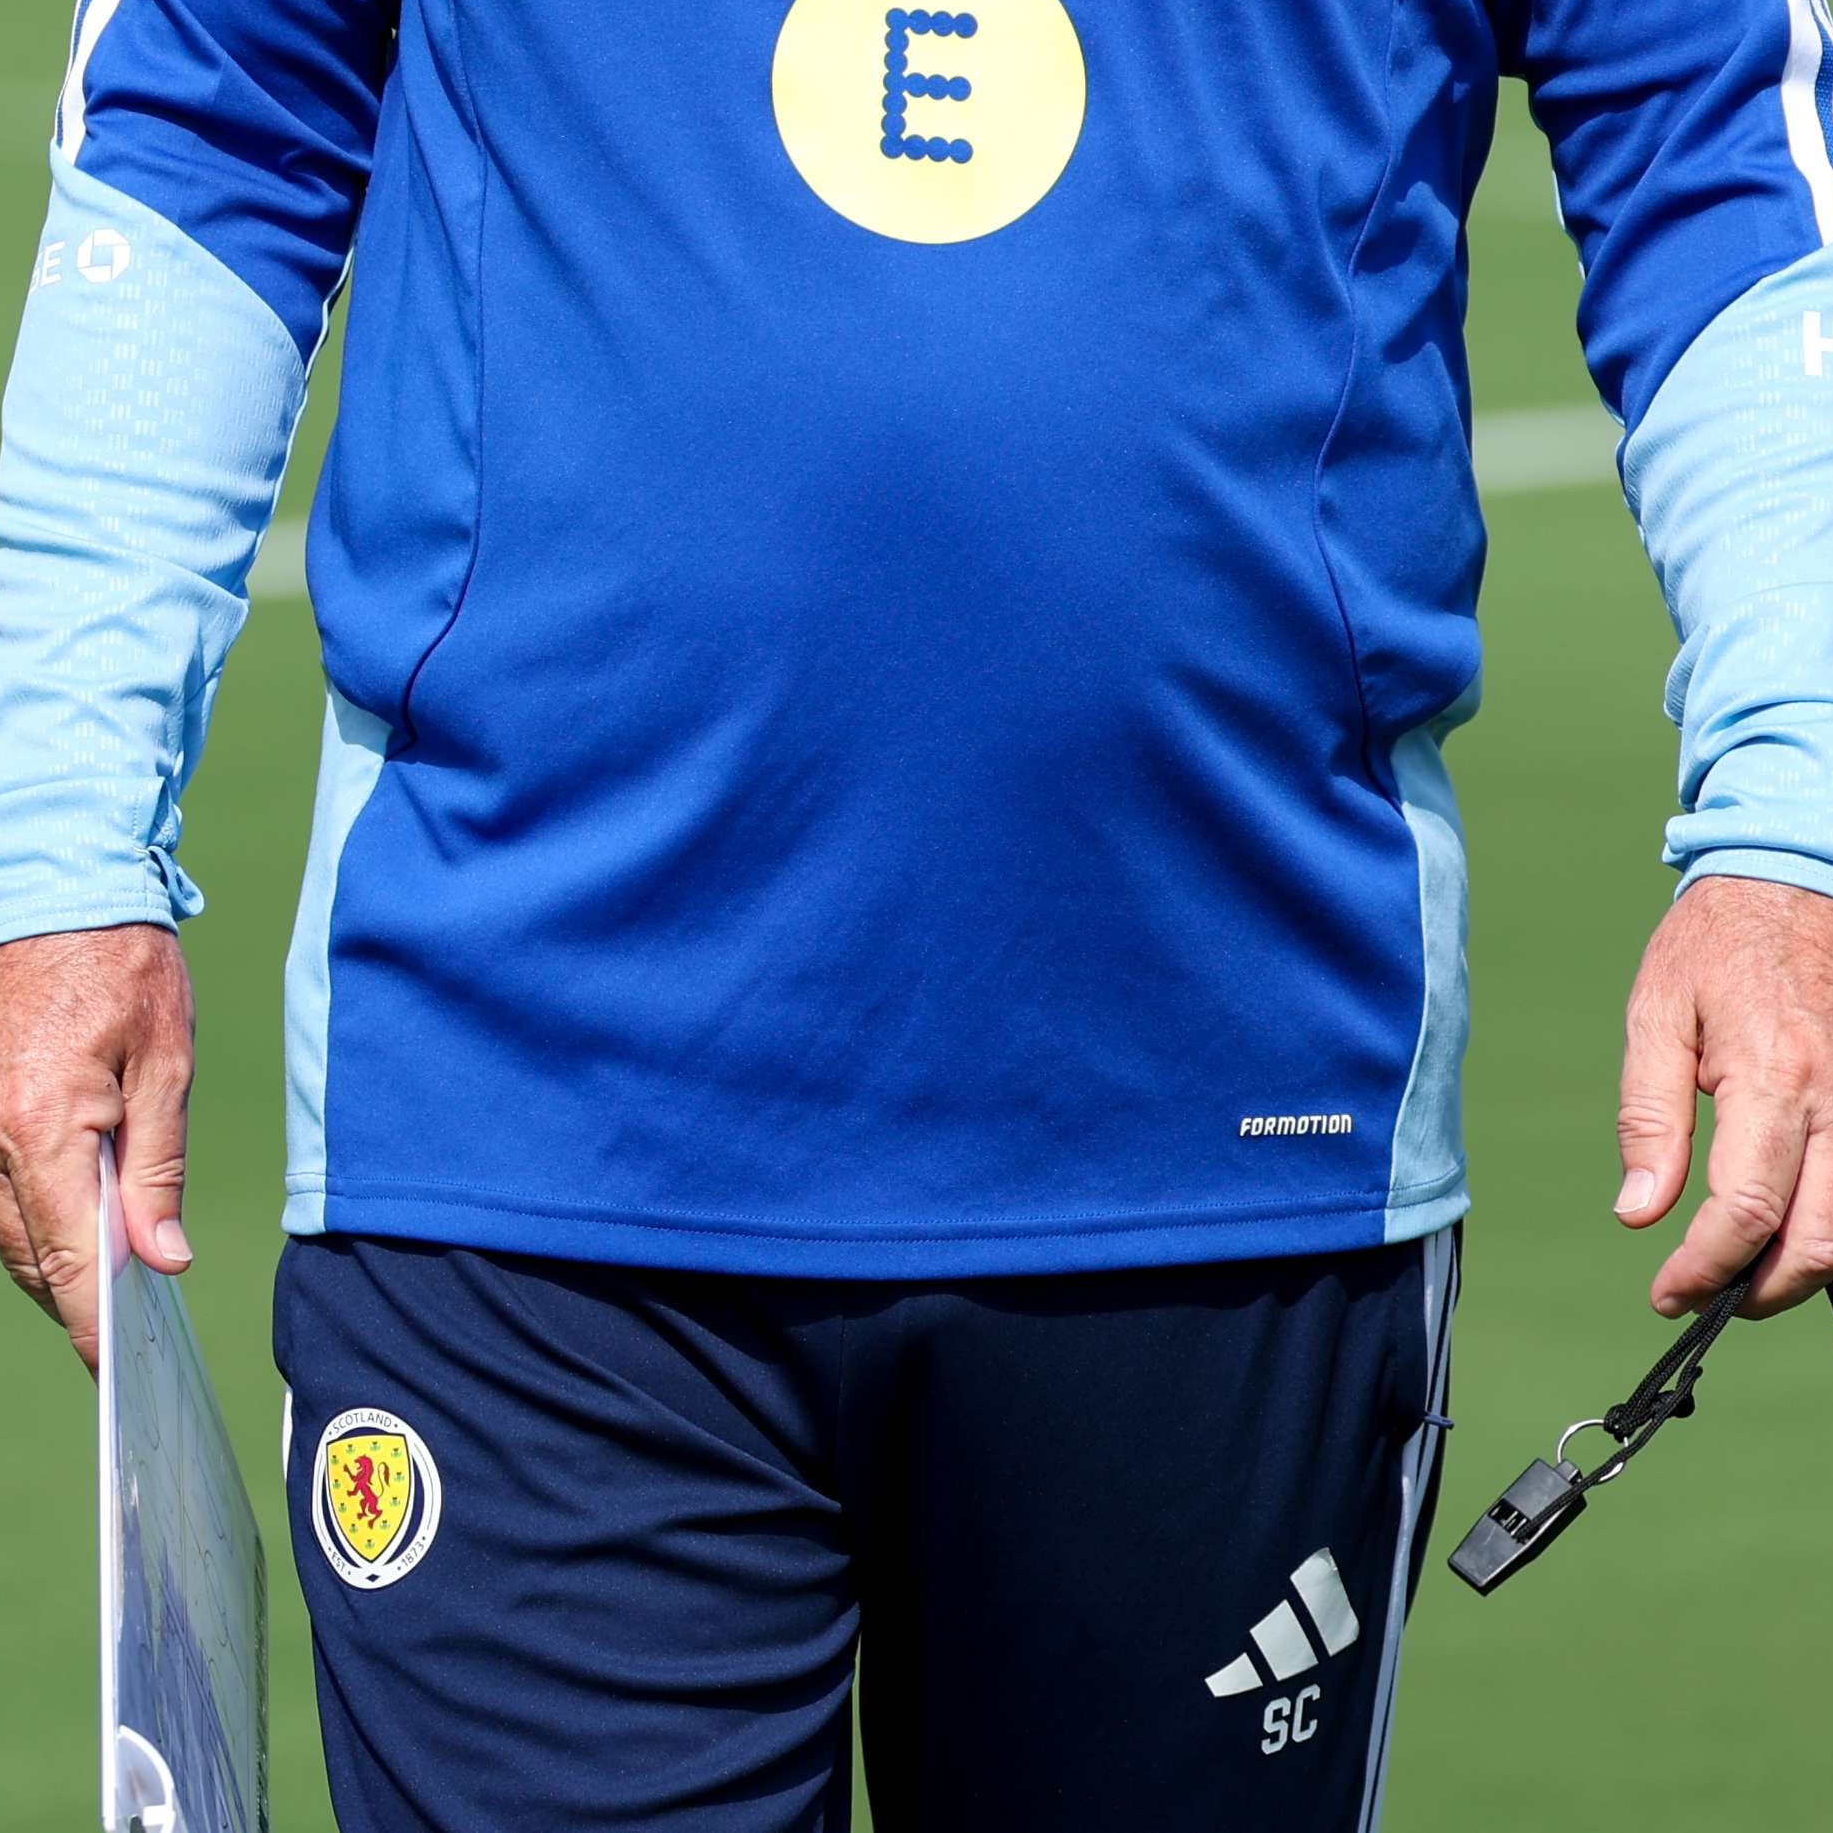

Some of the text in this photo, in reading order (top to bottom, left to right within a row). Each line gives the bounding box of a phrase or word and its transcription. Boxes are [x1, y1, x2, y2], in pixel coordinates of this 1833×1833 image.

[1239, 1114, 1353, 1138] FORMOTION
[332, 1412, 393, 1434] SCOTLAND
[330, 1551, 346, 1572] EST
[401, 1540, 425, 1567] 1873
[1260, 1682, 1321, 1755] SC
